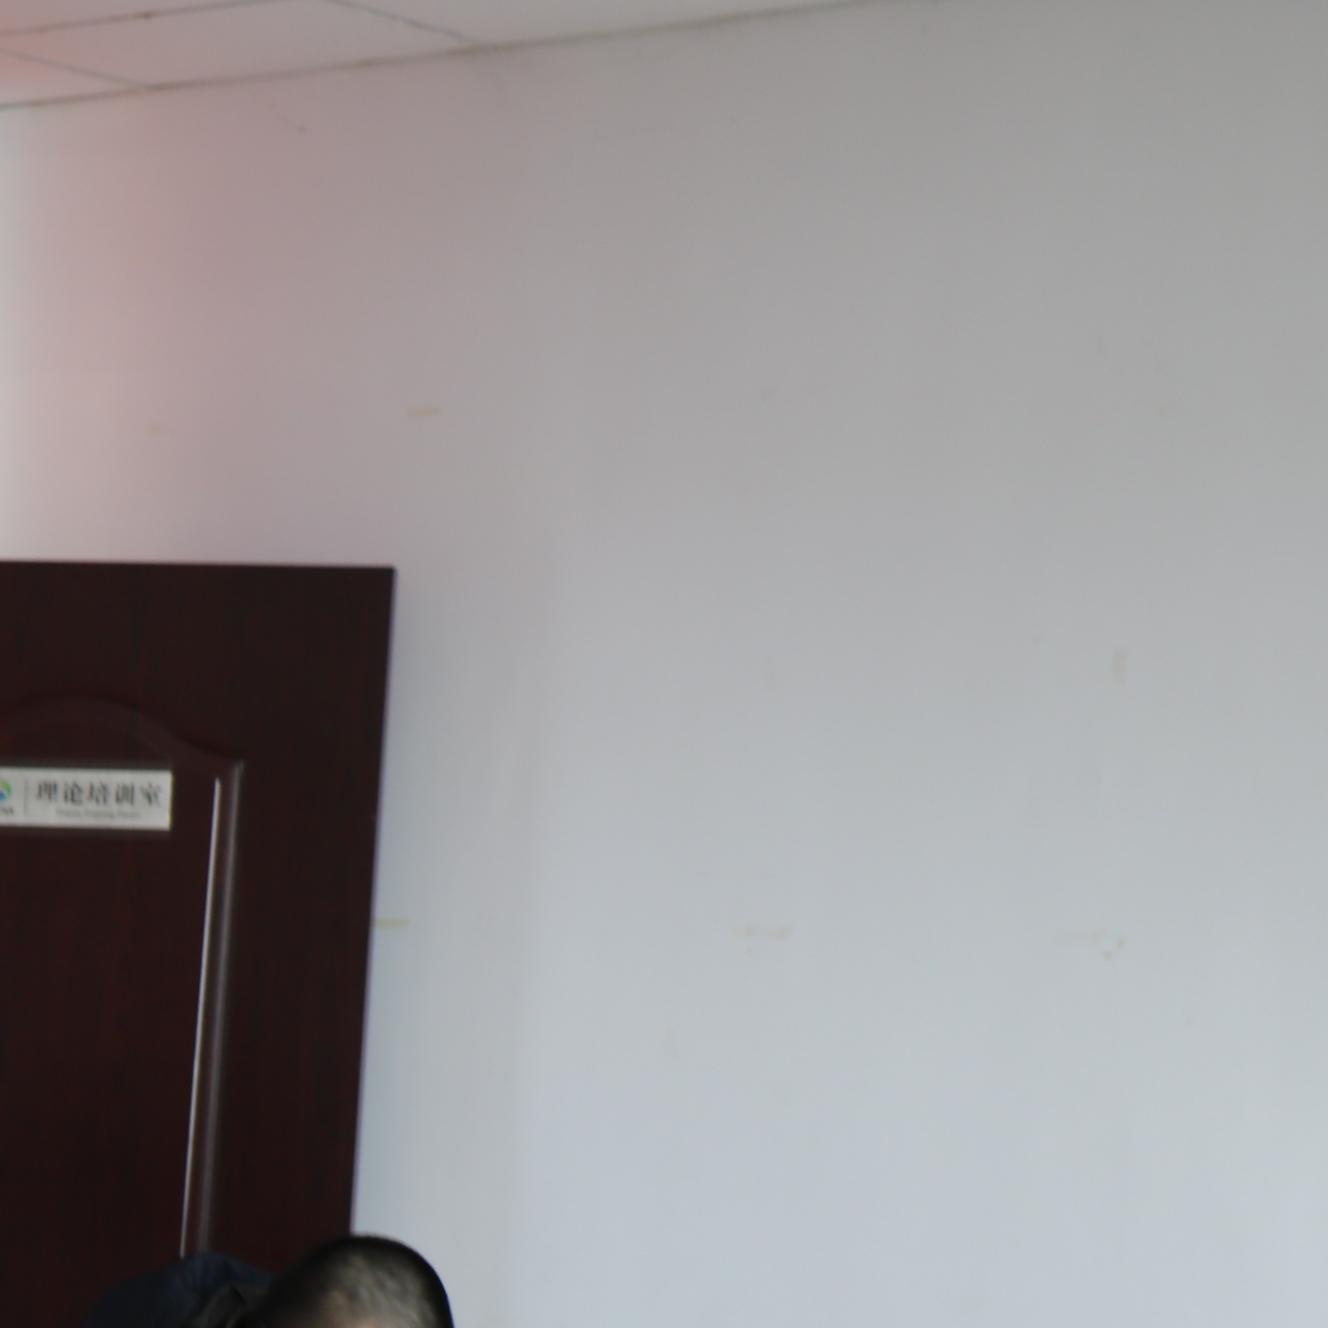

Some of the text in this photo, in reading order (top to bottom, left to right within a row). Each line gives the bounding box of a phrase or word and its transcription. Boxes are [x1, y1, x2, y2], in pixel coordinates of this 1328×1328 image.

[37, 779, 161, 807] 理论培训室
